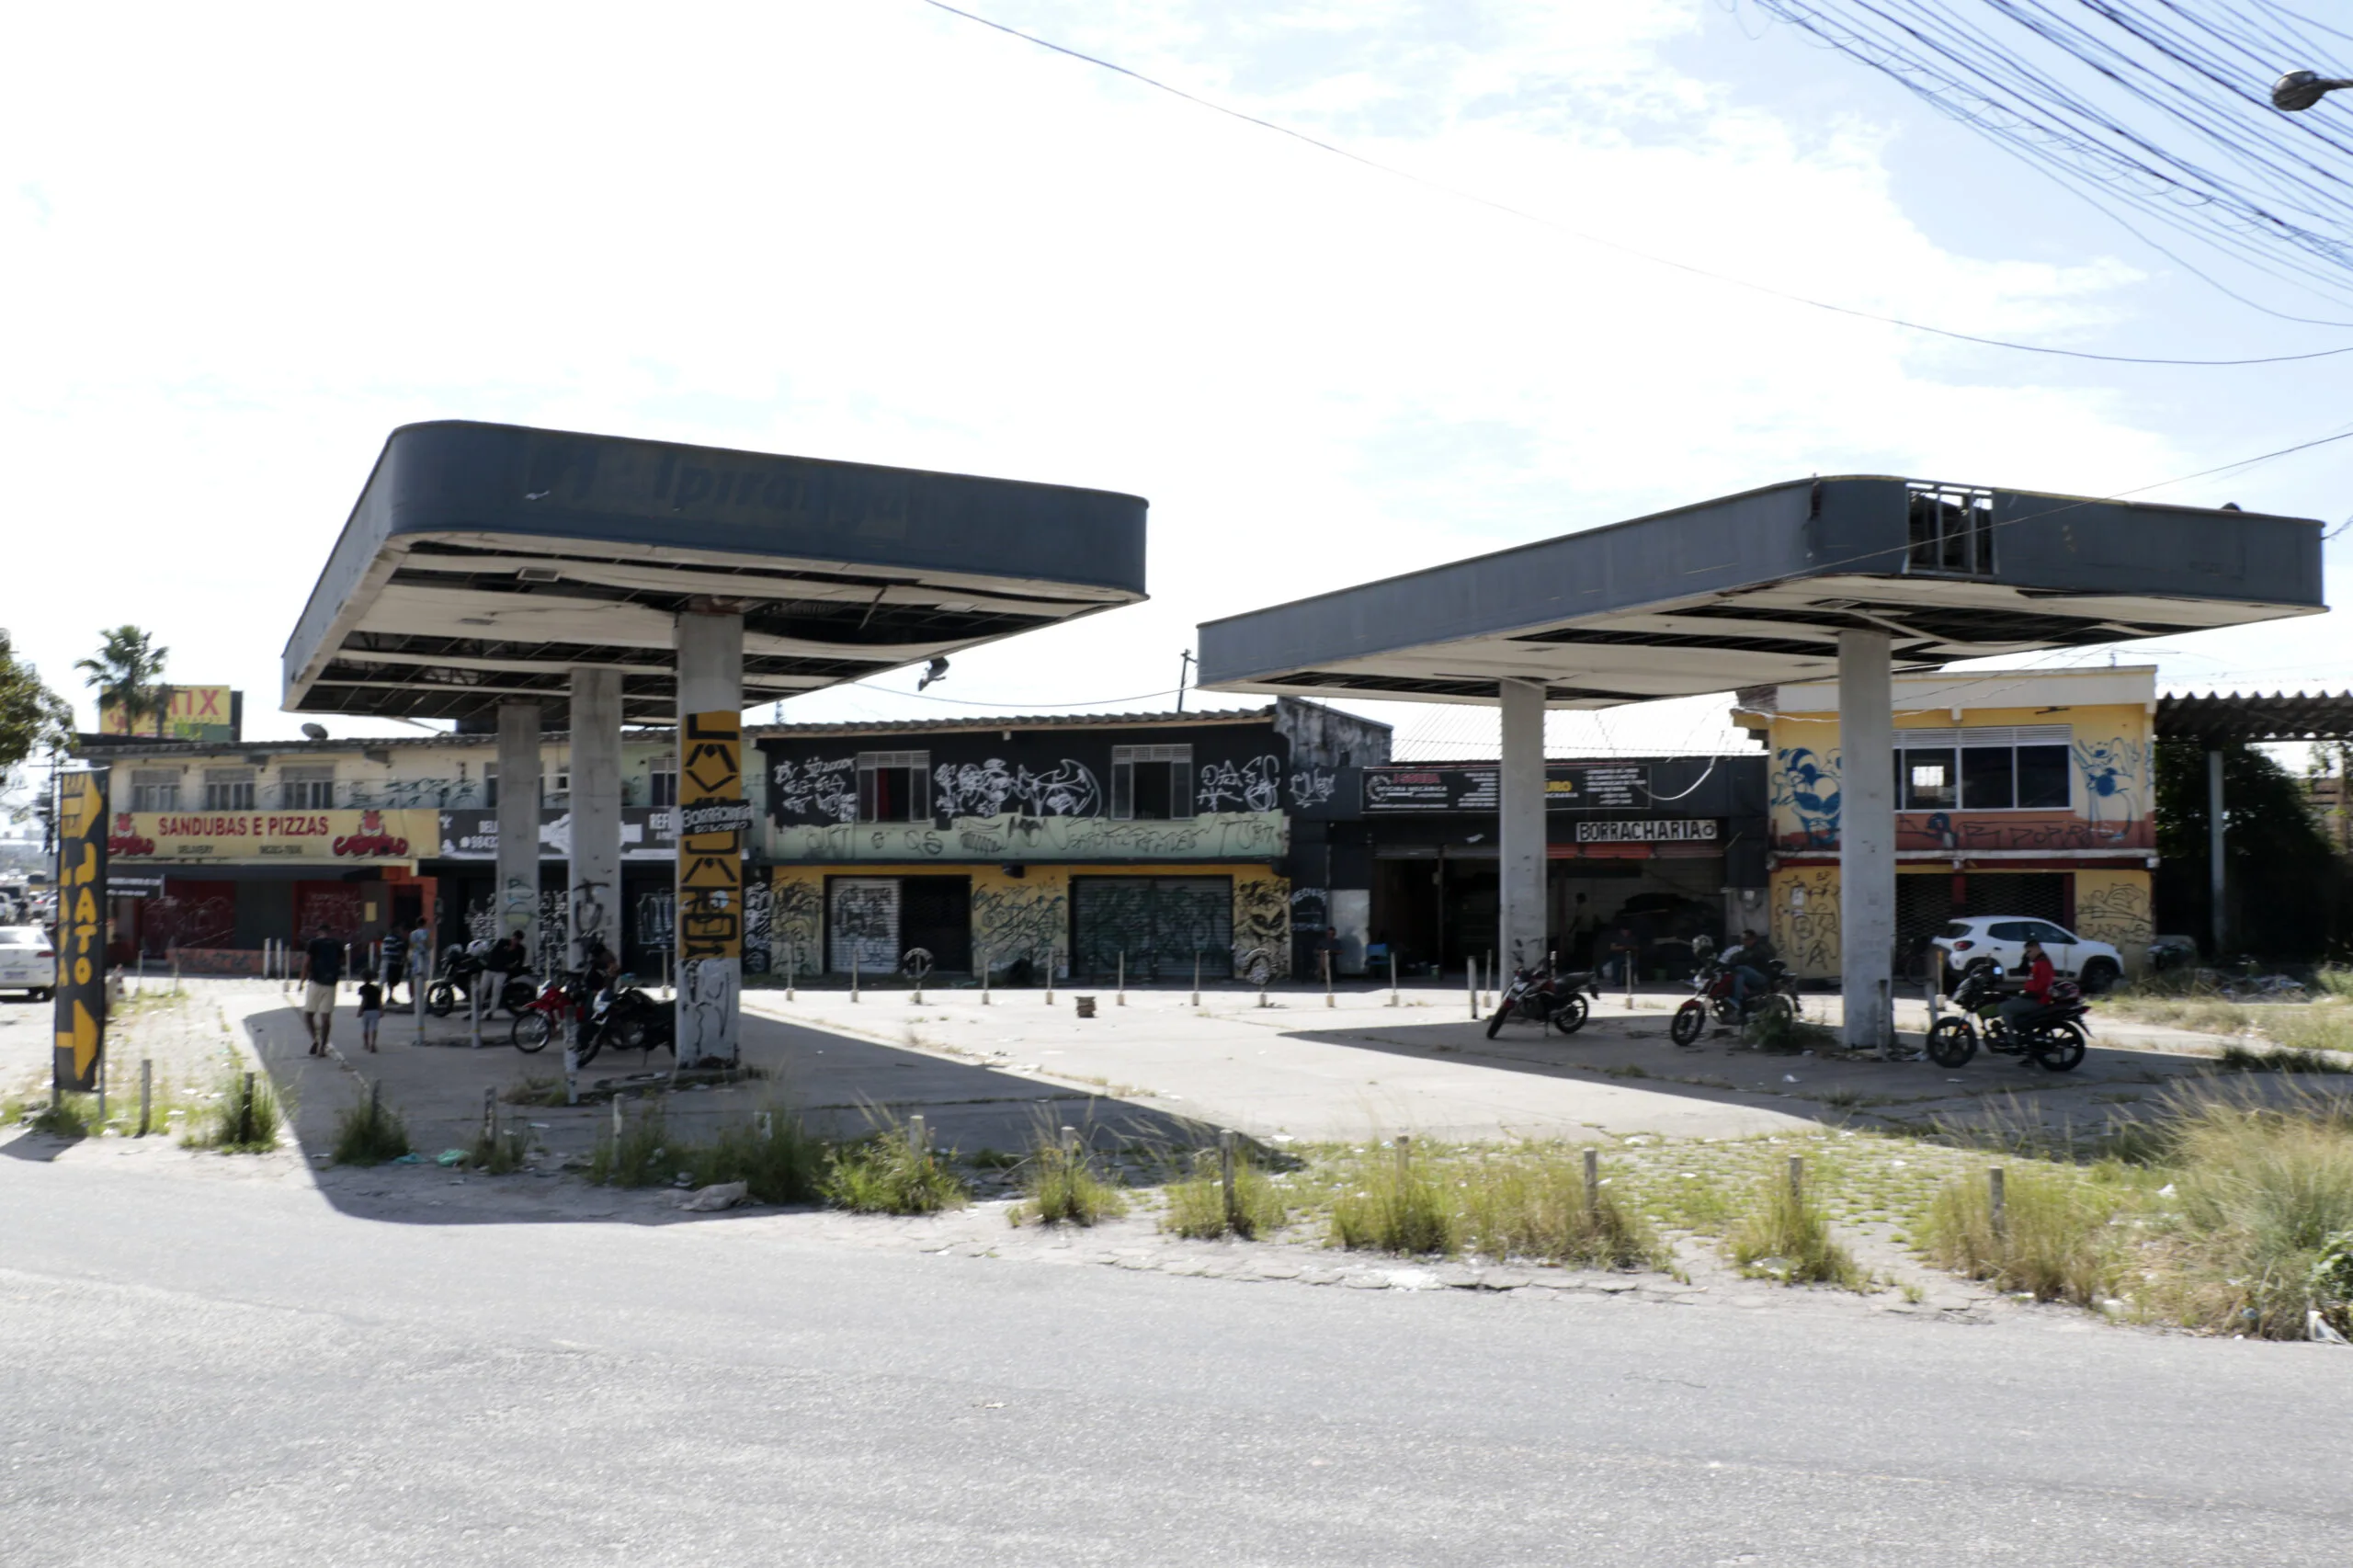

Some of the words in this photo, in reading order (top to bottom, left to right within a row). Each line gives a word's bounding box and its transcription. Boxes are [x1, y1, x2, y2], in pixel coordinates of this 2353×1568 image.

[158, 816, 247, 836] SANDUBAS
[253, 816, 263, 835] E
[268, 815, 329, 835] PIZZAS
[1579, 821, 1702, 841] BORRACHARIA
[74, 842, 97, 985] JATO
